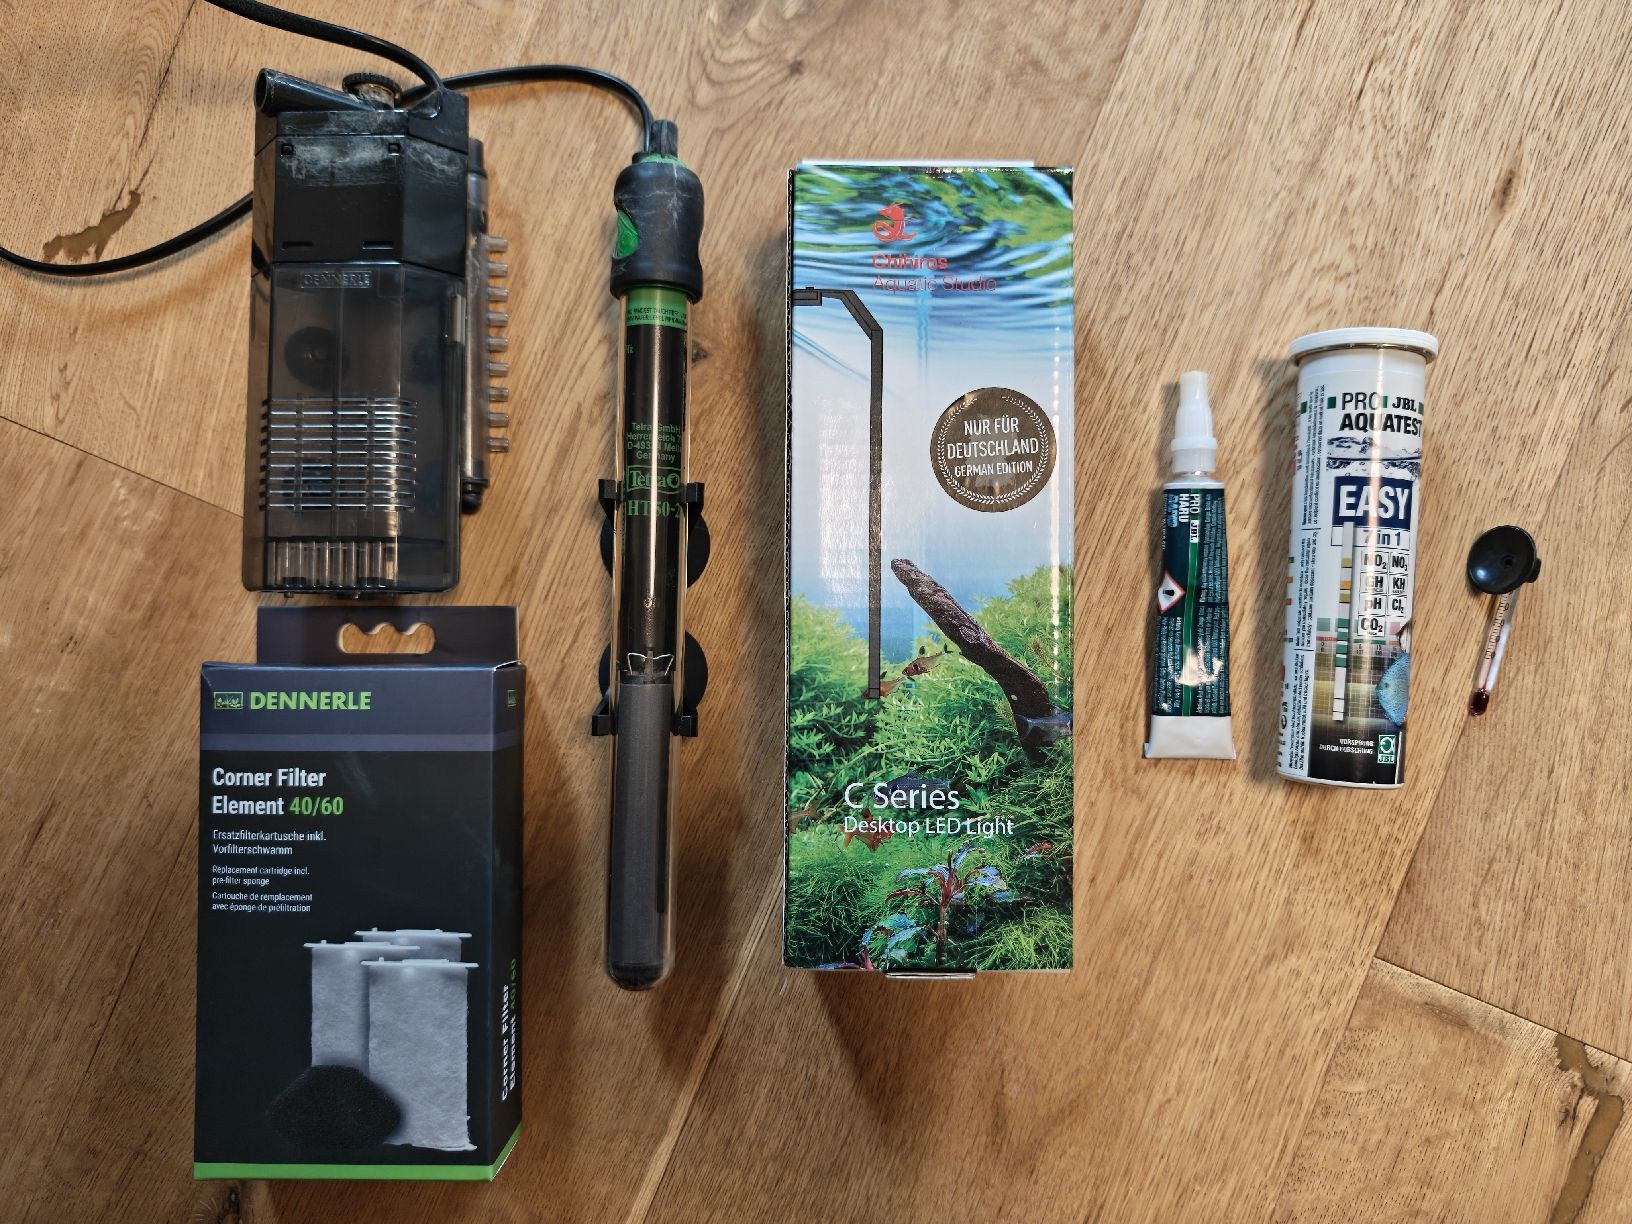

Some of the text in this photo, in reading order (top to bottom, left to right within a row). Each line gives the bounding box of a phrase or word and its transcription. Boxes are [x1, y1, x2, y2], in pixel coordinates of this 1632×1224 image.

[872, 252, 948, 270] Chihiros
[872, 275, 997, 294] Aquatic Studio
[1341, 392, 1417, 413] PRO JBL
[631, 422, 681, 433] Tetra GmbH
[964, 414, 1019, 436] NUR FÜR
[1339, 412, 1422, 437] AQUATEST
[947, 437, 1039, 460] DEUTSCHLAND
[954, 460, 1033, 478] GERMAN EDITION
[629, 470, 667, 488] Teta
[1178, 493, 1190, 523] HARU
[1190, 493, 1201, 514] PRO
[1338, 485, 1410, 520] EASY
[1376, 531, 1391, 545] in
[1392, 577, 1406, 590] KH
[250, 691, 372, 710] DENNERLE
[1378, 755, 1394, 763] JBL
[212, 767, 327, 788] Corner Filter
[844, 782, 960, 810] C Series
[212, 795, 345, 817] Element 40/60
[213, 829, 327, 841] Ersatzfilterkartusche inkl.
[844, 816, 1014, 839] Desktop LED Light
[212, 843, 293, 855] Vorfilterschwamm
[212, 864, 310, 877] Replacement cartridge incl.
[212, 875, 270, 887] pre-filter sponge
[212, 891, 313, 903] Cartouche de remplacement
[212, 902, 311, 913] avec éponge de préfiltration
